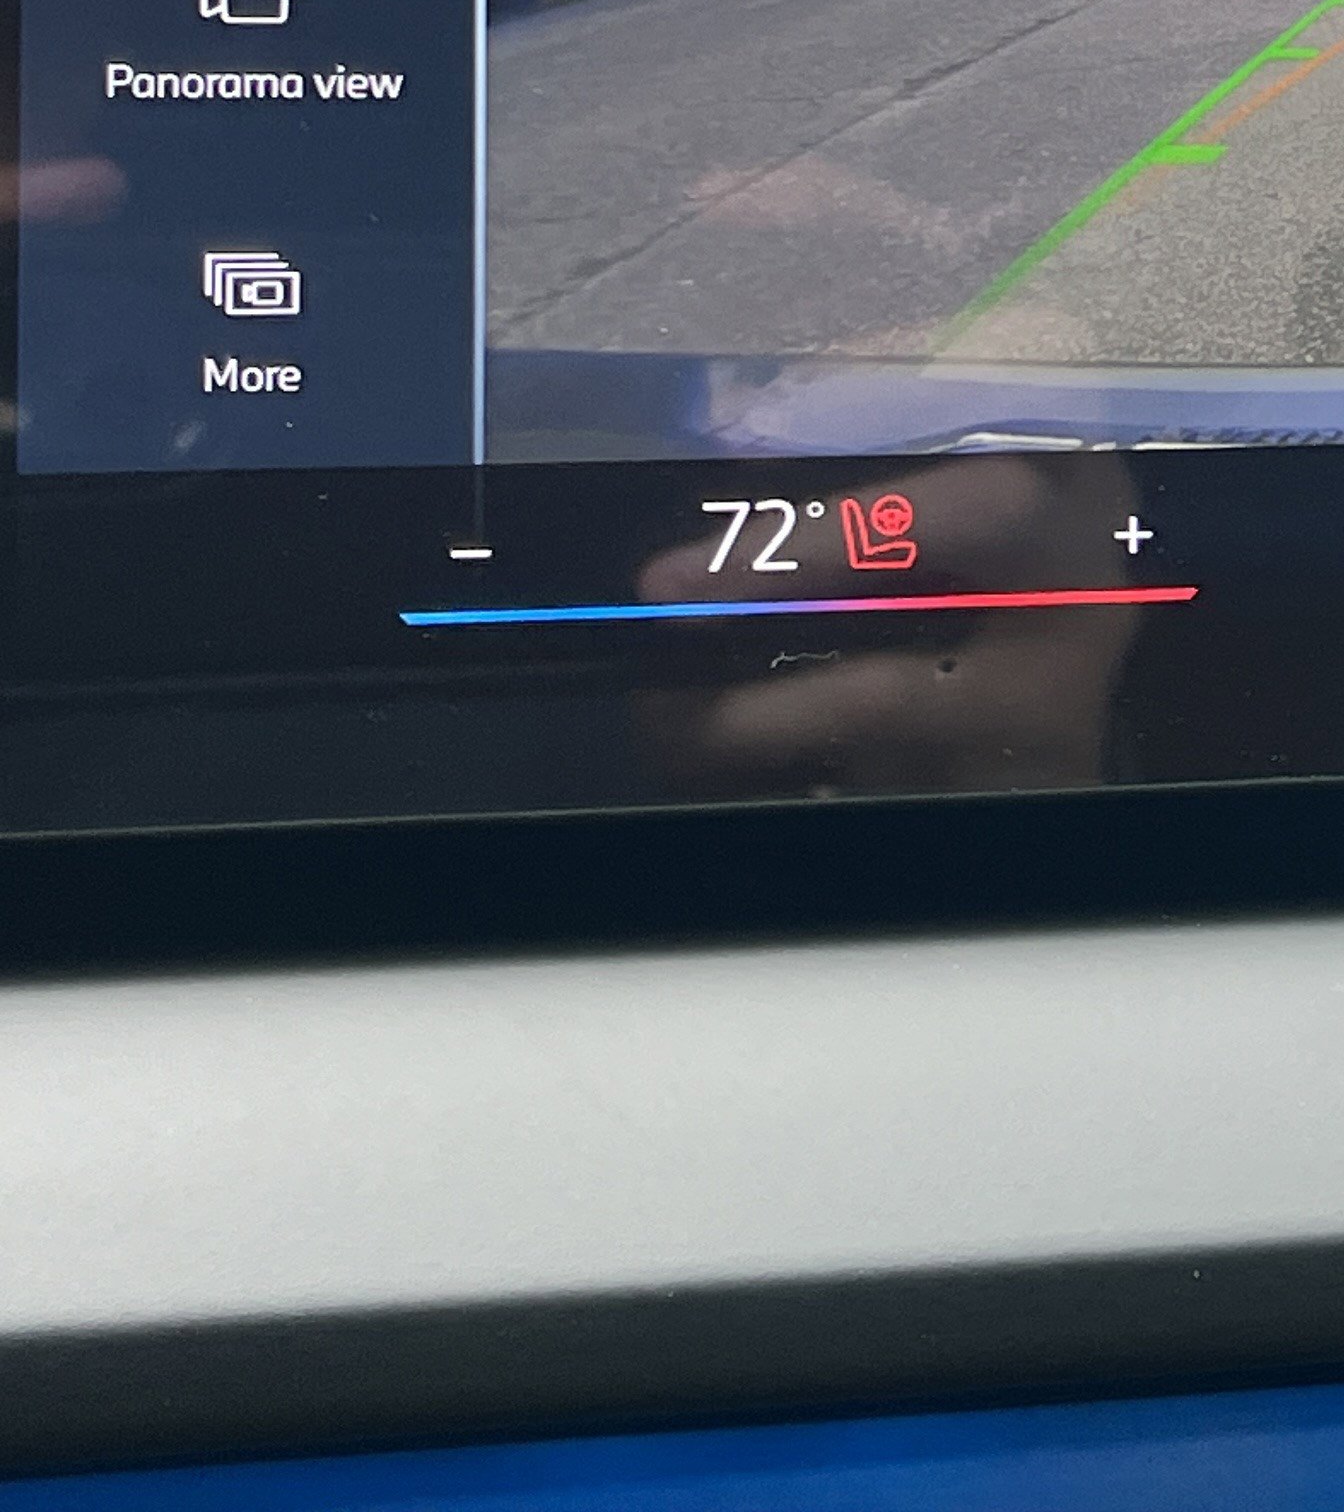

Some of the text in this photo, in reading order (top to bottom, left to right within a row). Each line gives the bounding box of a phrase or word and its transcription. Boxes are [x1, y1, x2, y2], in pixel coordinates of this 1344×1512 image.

[107, 63, 404, 99] Panorama view
[204, 357, 302, 392] More
